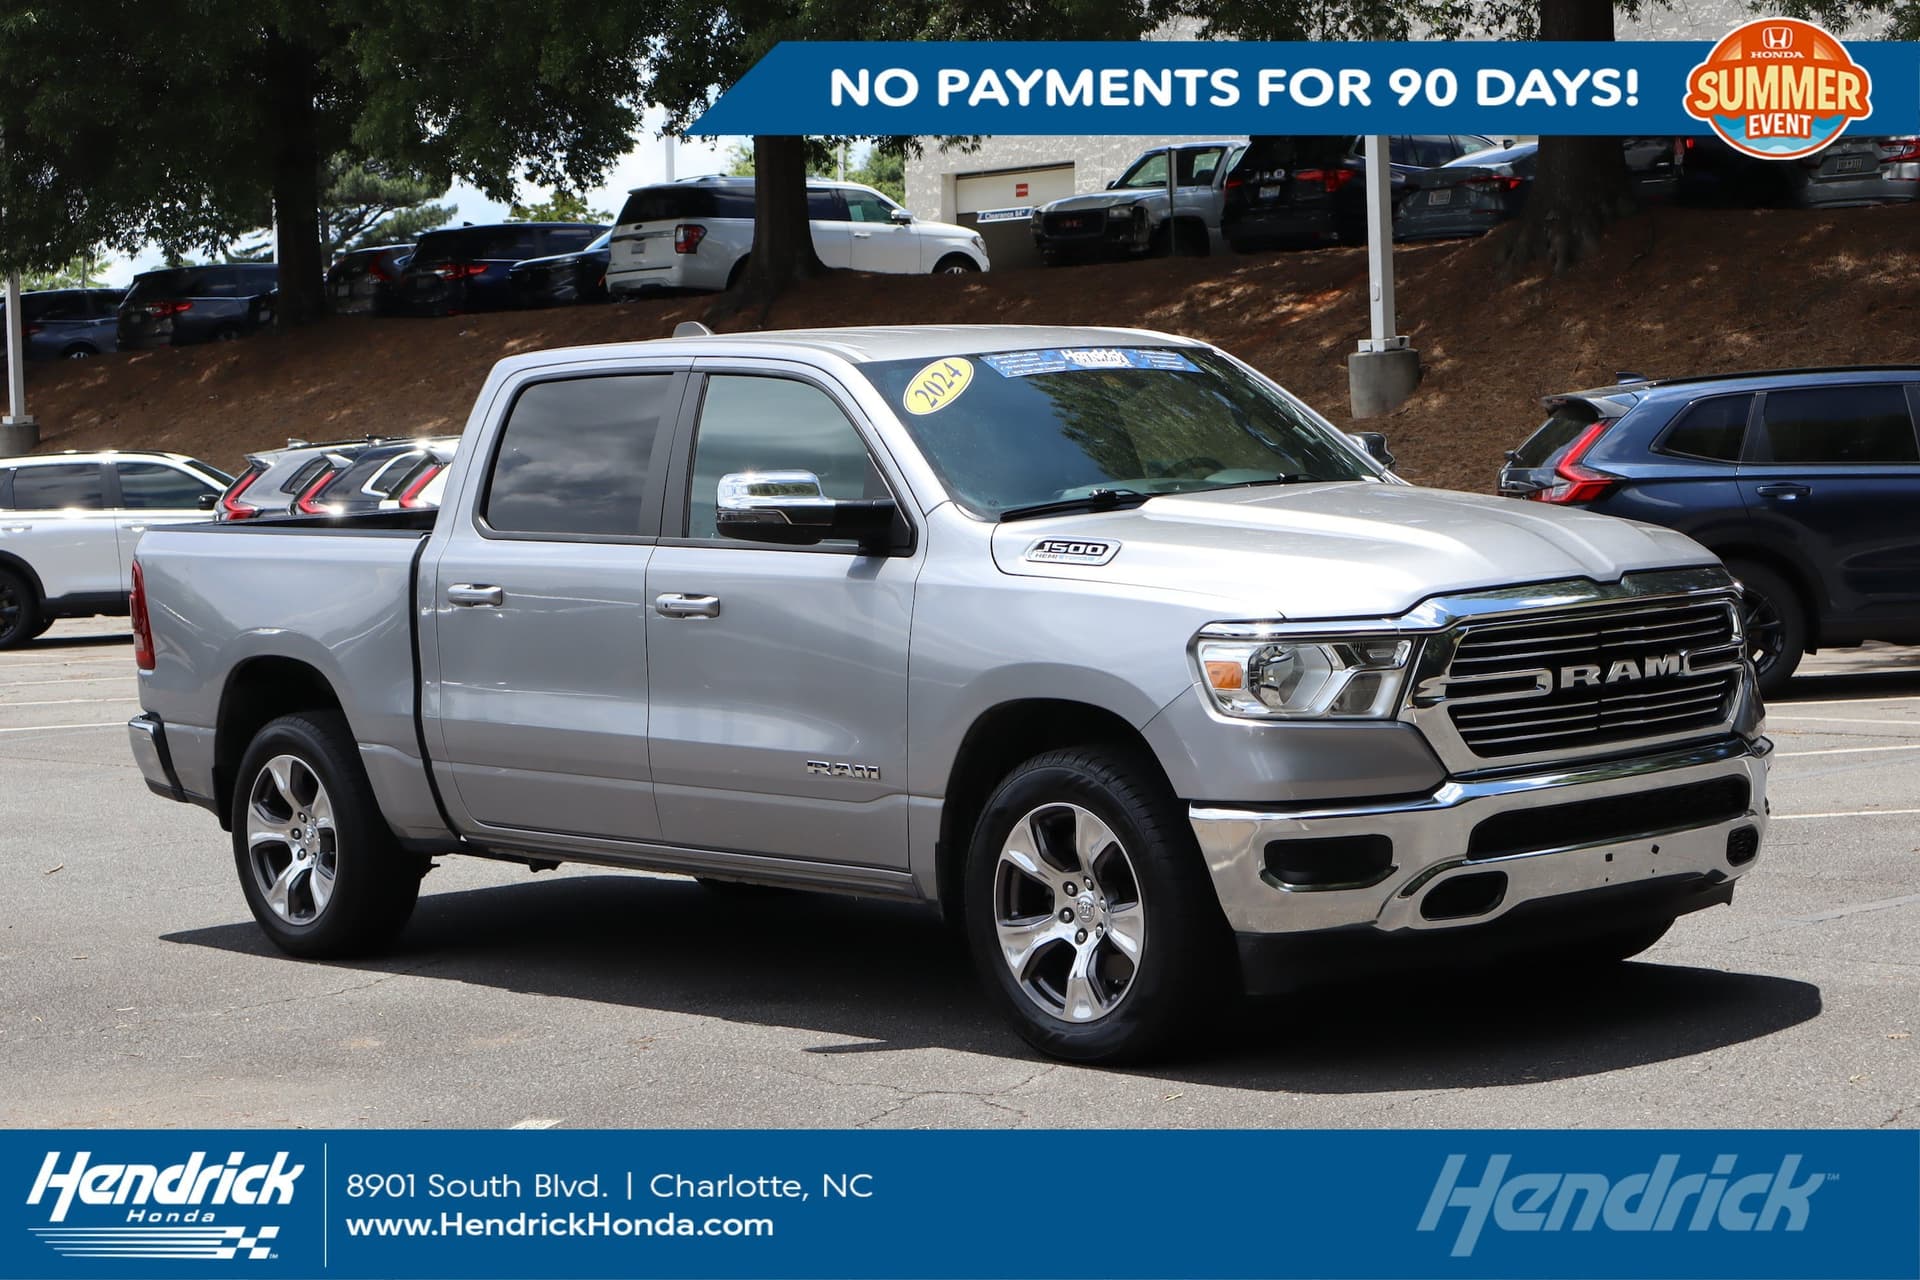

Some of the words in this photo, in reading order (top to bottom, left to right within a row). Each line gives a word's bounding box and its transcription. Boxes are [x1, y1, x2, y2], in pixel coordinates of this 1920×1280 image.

[914, 362, 962, 408] 2024
[1034, 541, 1105, 556] 1500
[1560, 654, 1680, 689] RAM
[806, 759, 880, 780] RAM
